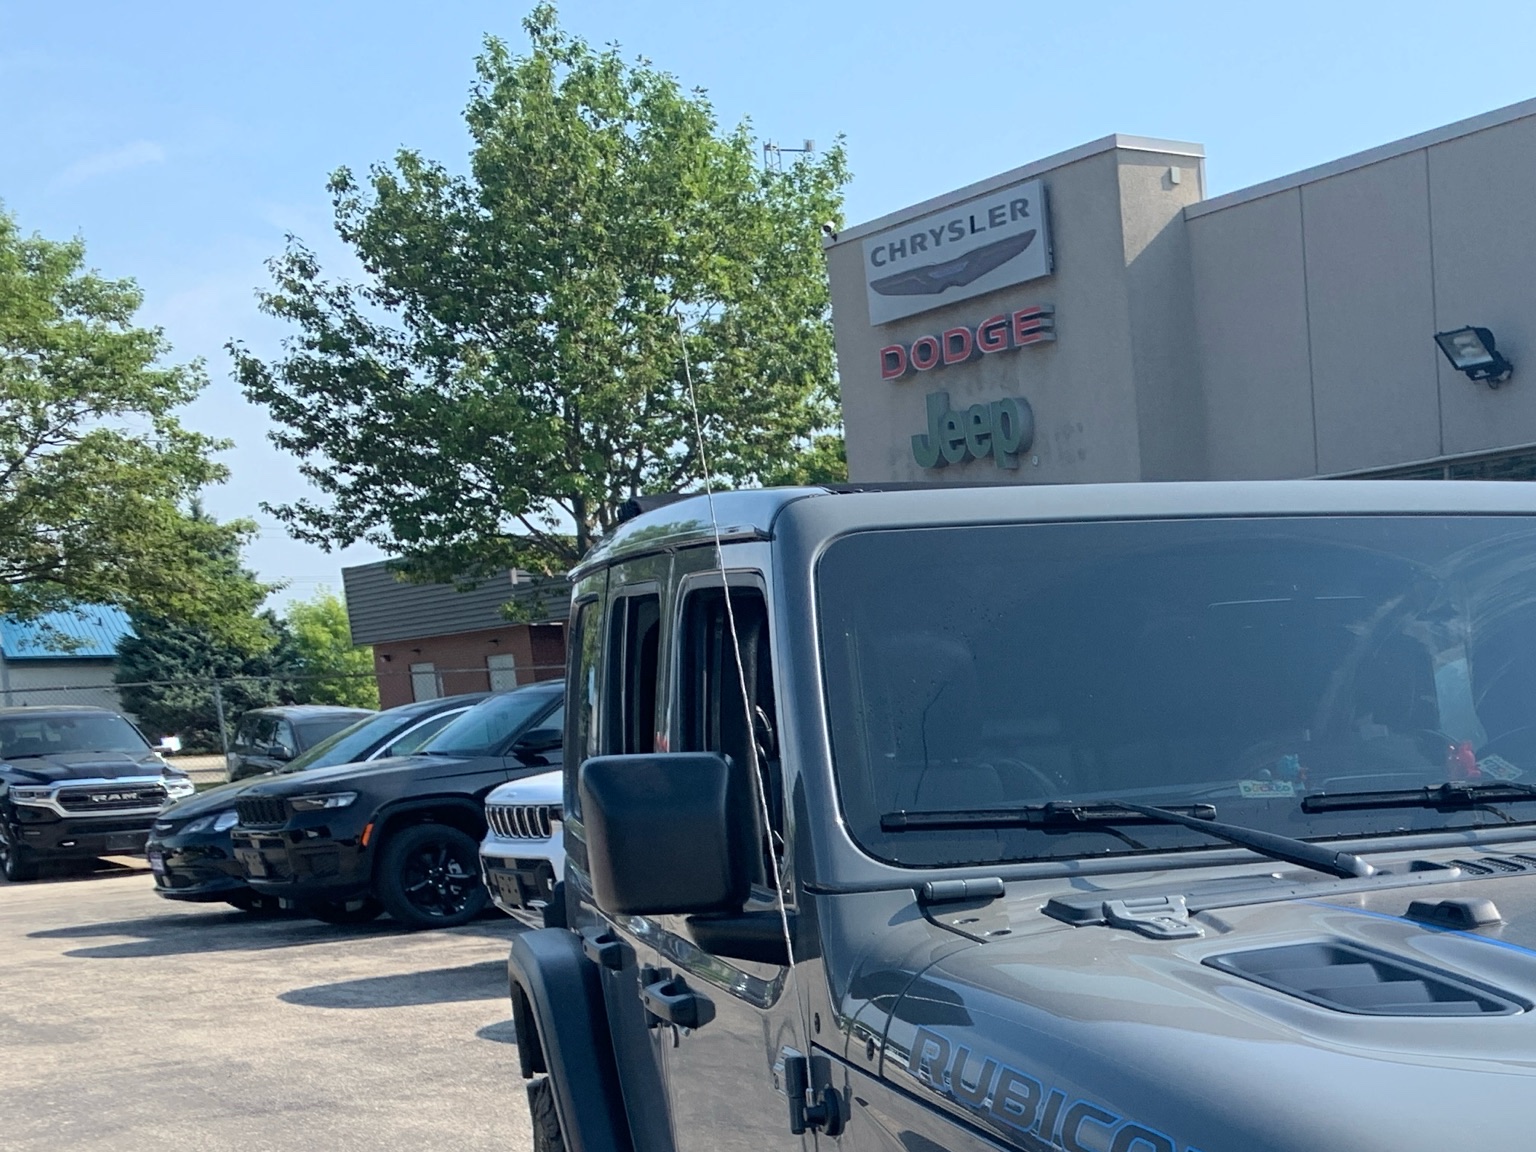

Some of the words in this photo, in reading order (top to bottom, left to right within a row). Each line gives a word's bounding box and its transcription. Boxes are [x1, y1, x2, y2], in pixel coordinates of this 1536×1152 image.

[870, 197, 1031, 268] CHRYSLER
[879, 305, 1046, 381] DODGE
[911, 391, 1028, 469] Jeep
[91, 792, 138, 803] RAM
